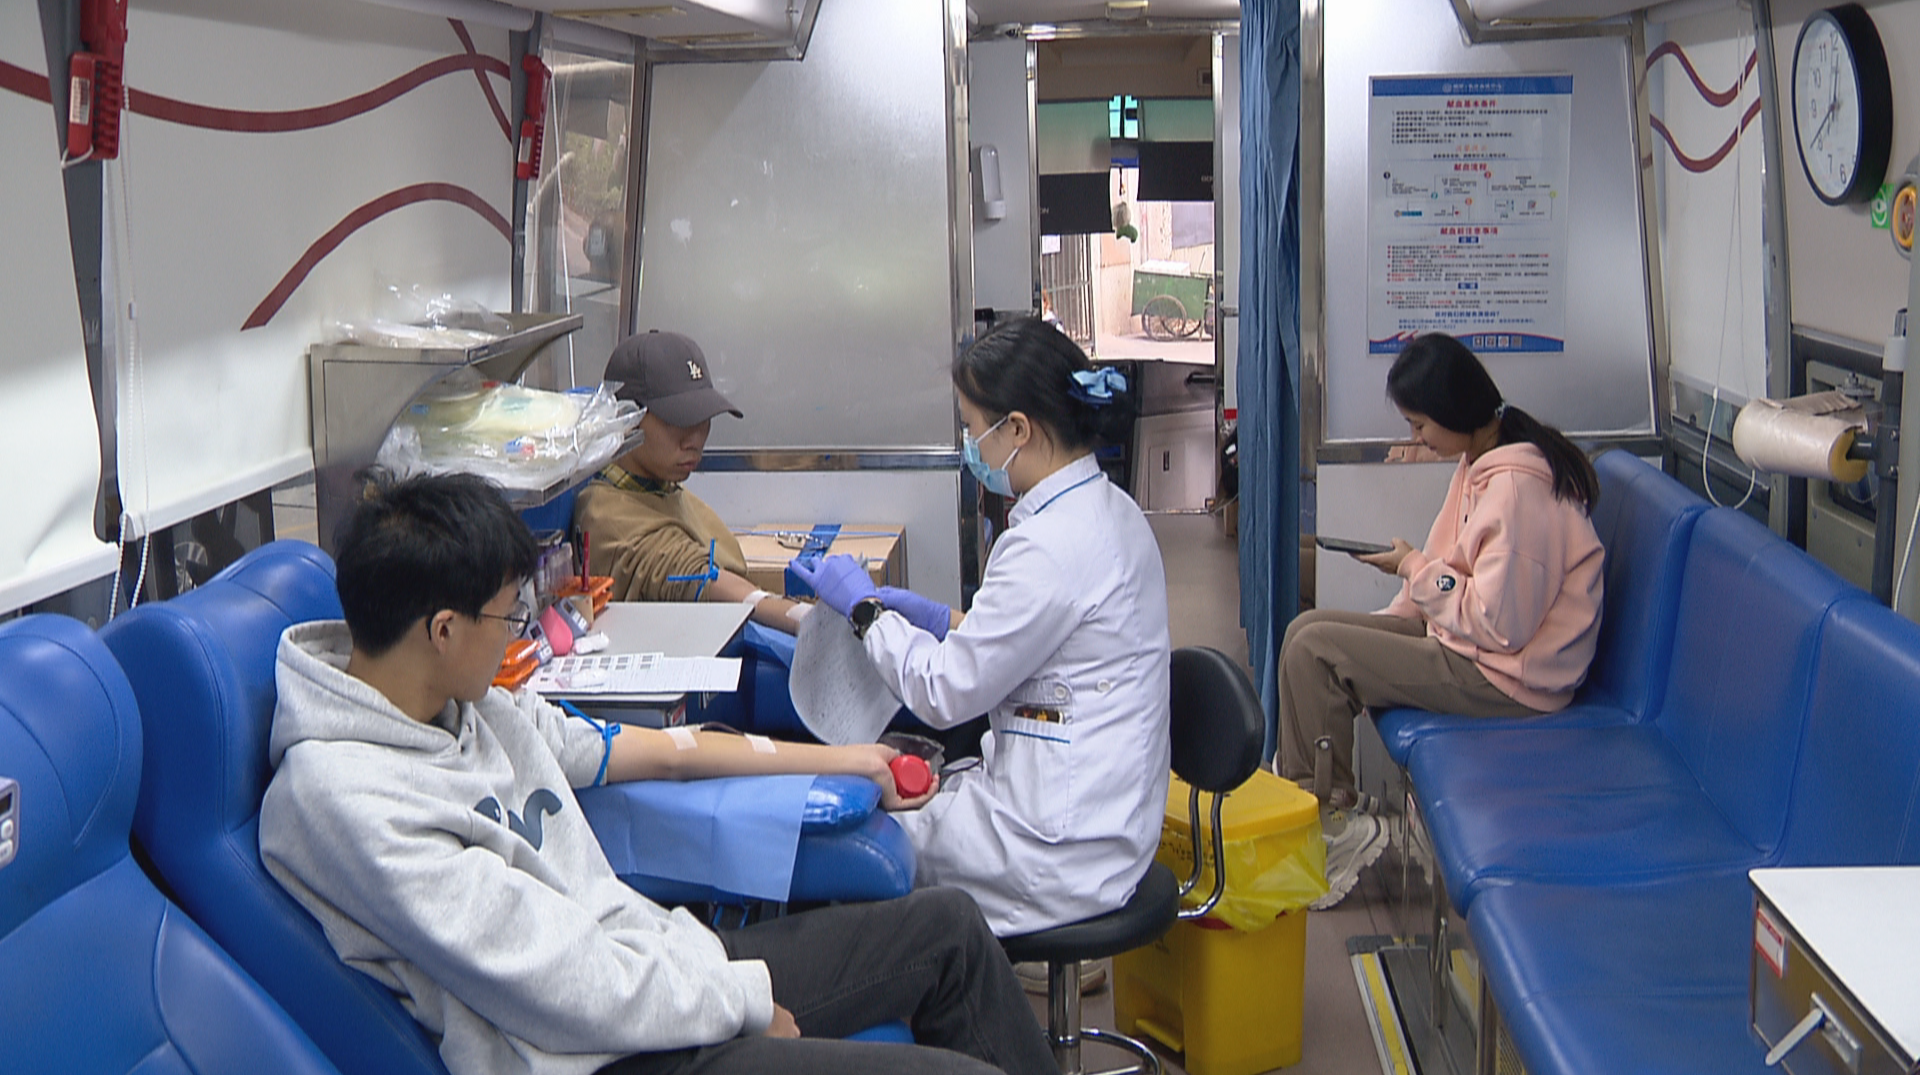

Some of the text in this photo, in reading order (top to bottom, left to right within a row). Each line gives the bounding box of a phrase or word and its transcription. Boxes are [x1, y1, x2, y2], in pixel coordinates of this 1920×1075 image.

[1830, 31, 1839, 50] 12
[1819, 43, 1826, 62] 11
[1812, 68, 1821, 88] 10
[1811, 99, 1817, 118] 9
[1827, 153, 1833, 175] 7
[1840, 162, 1847, 185] 6
[687, 360, 703, 380] LA
